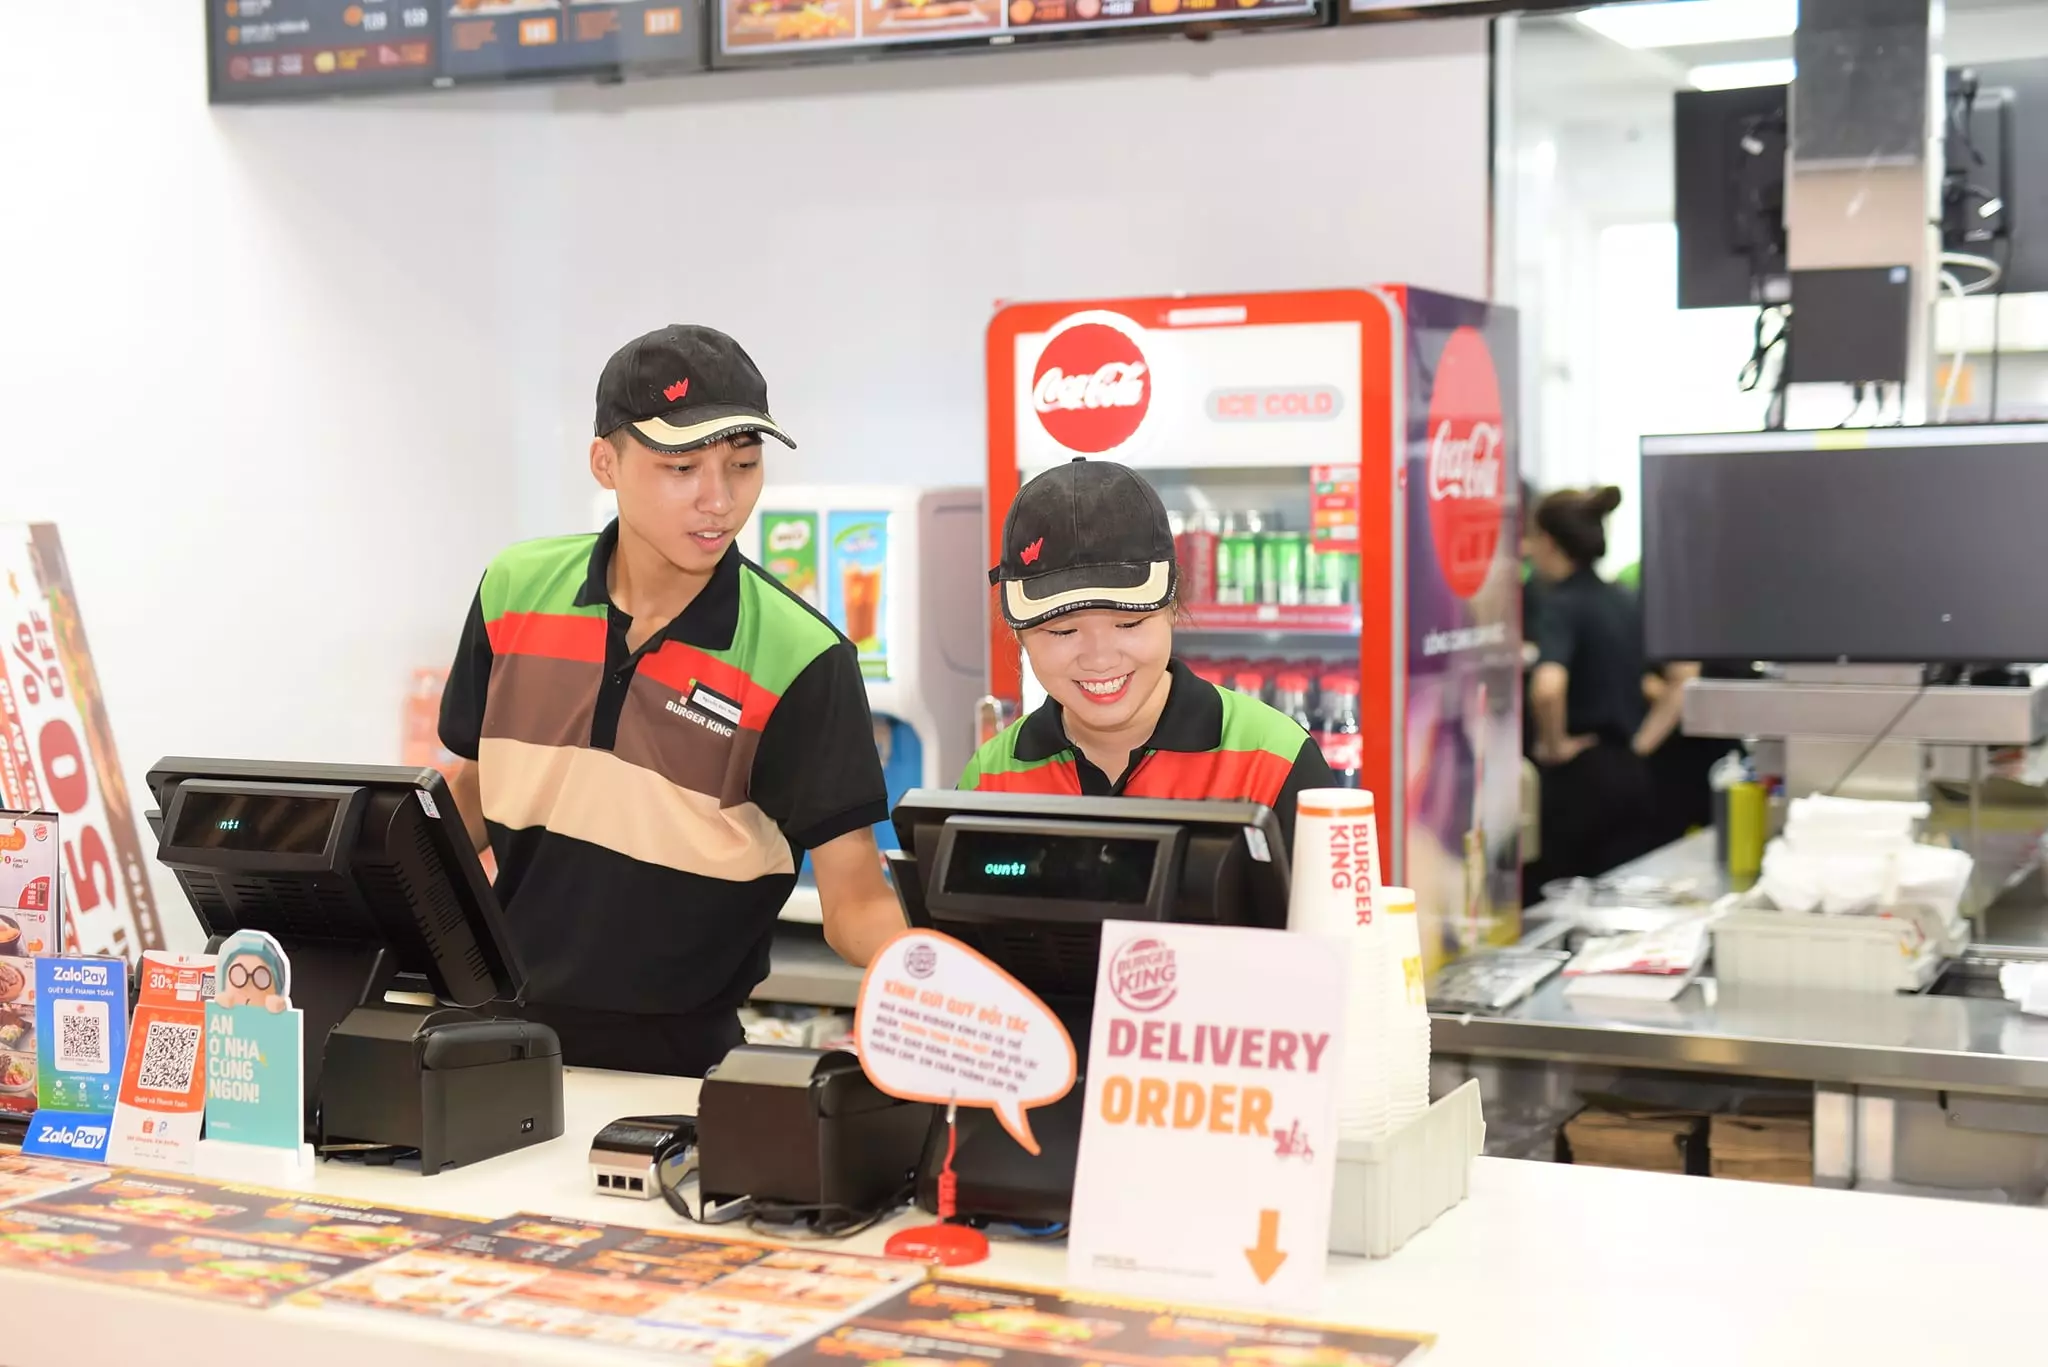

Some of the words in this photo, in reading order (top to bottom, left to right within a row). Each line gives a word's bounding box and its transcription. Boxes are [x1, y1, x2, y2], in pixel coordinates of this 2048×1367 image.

[1217, 393, 1258, 418] ICE
[1263, 391, 1334, 416] COLD
[665, 700, 705, 726] BURGER
[706, 719, 732, 737] KING
[1329, 824, 1352, 890] KING
[1352, 823, 1372, 926] BURGER
[54, 966, 107, 985] ZaloPay
[1118, 950, 1176, 974] BURGER
[1119, 964, 1177, 994] KING
[1107, 1018, 1330, 1073] DELIVERY
[1100, 1075, 1274, 1137] ORDER
[38, 1126, 107, 1149] ZaloPay
